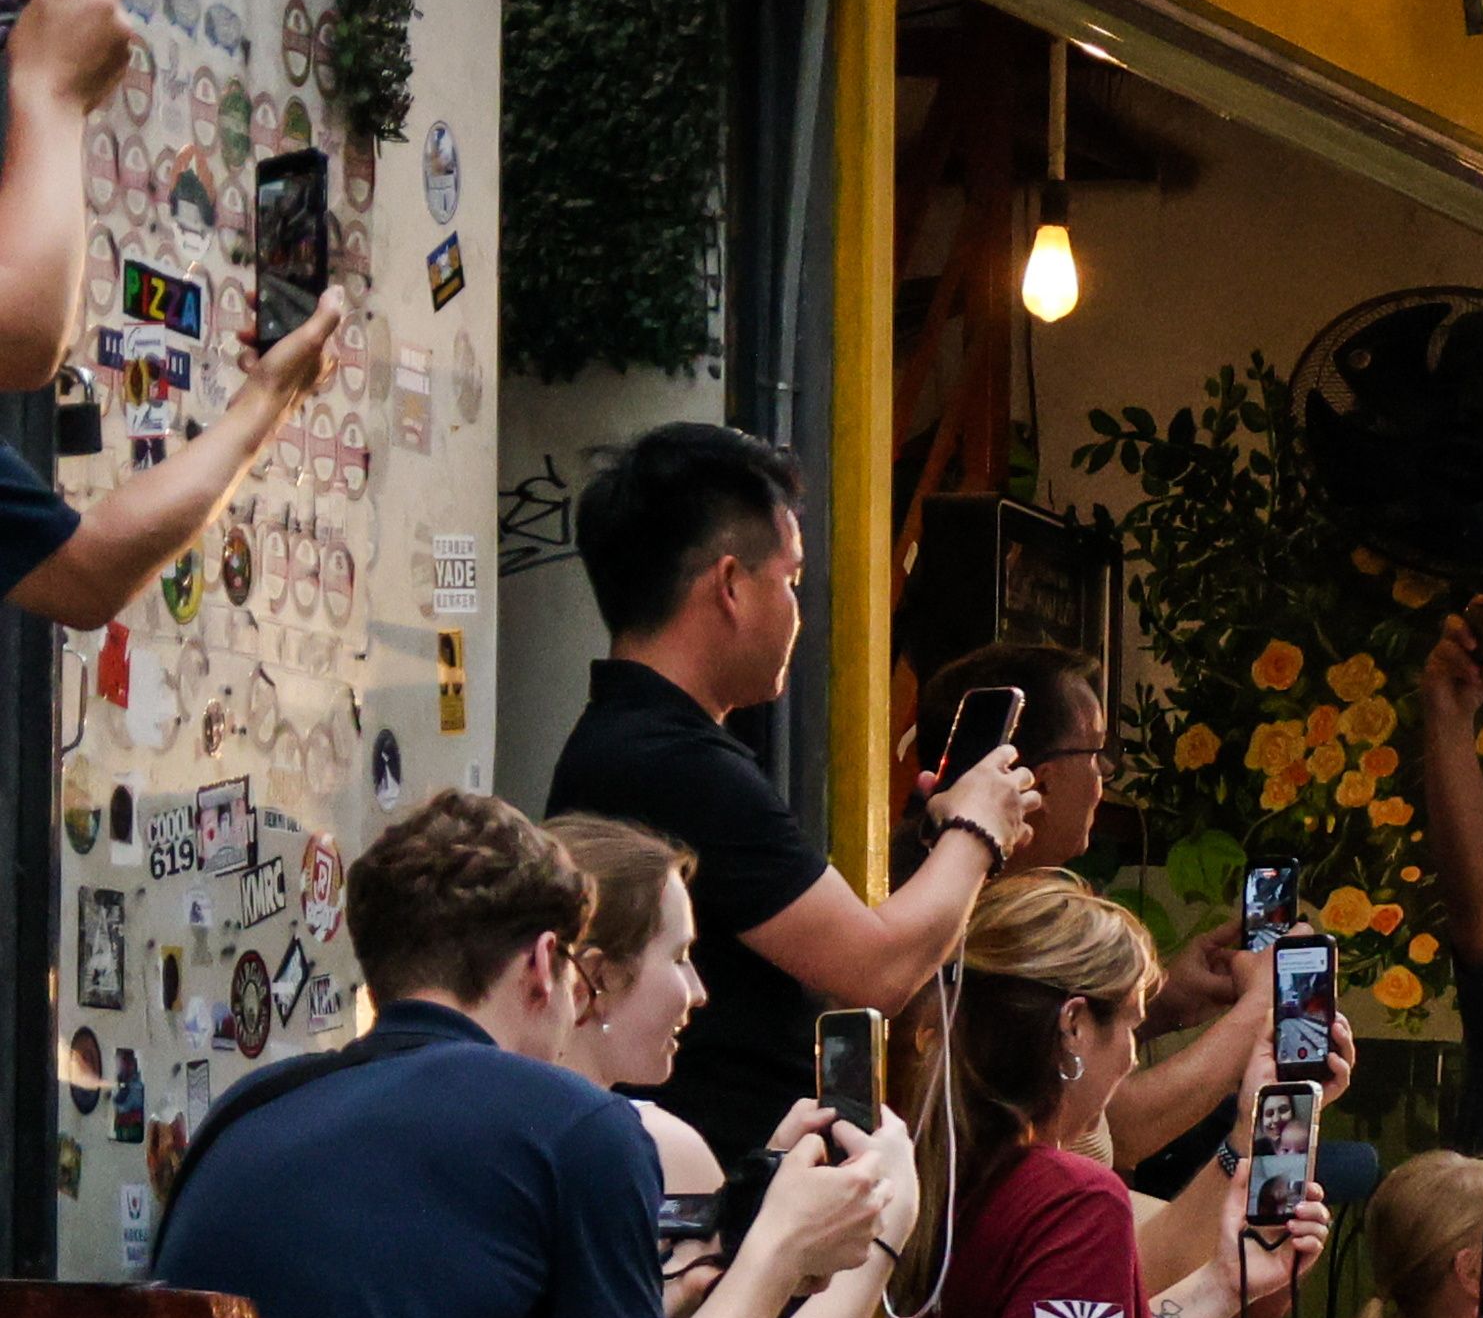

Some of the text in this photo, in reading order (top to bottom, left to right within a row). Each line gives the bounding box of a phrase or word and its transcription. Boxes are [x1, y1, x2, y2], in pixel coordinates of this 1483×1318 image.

[125, 268, 199, 333] PIZZA
[435, 560, 475, 587] YADE
[150, 838, 195, 880] 619
